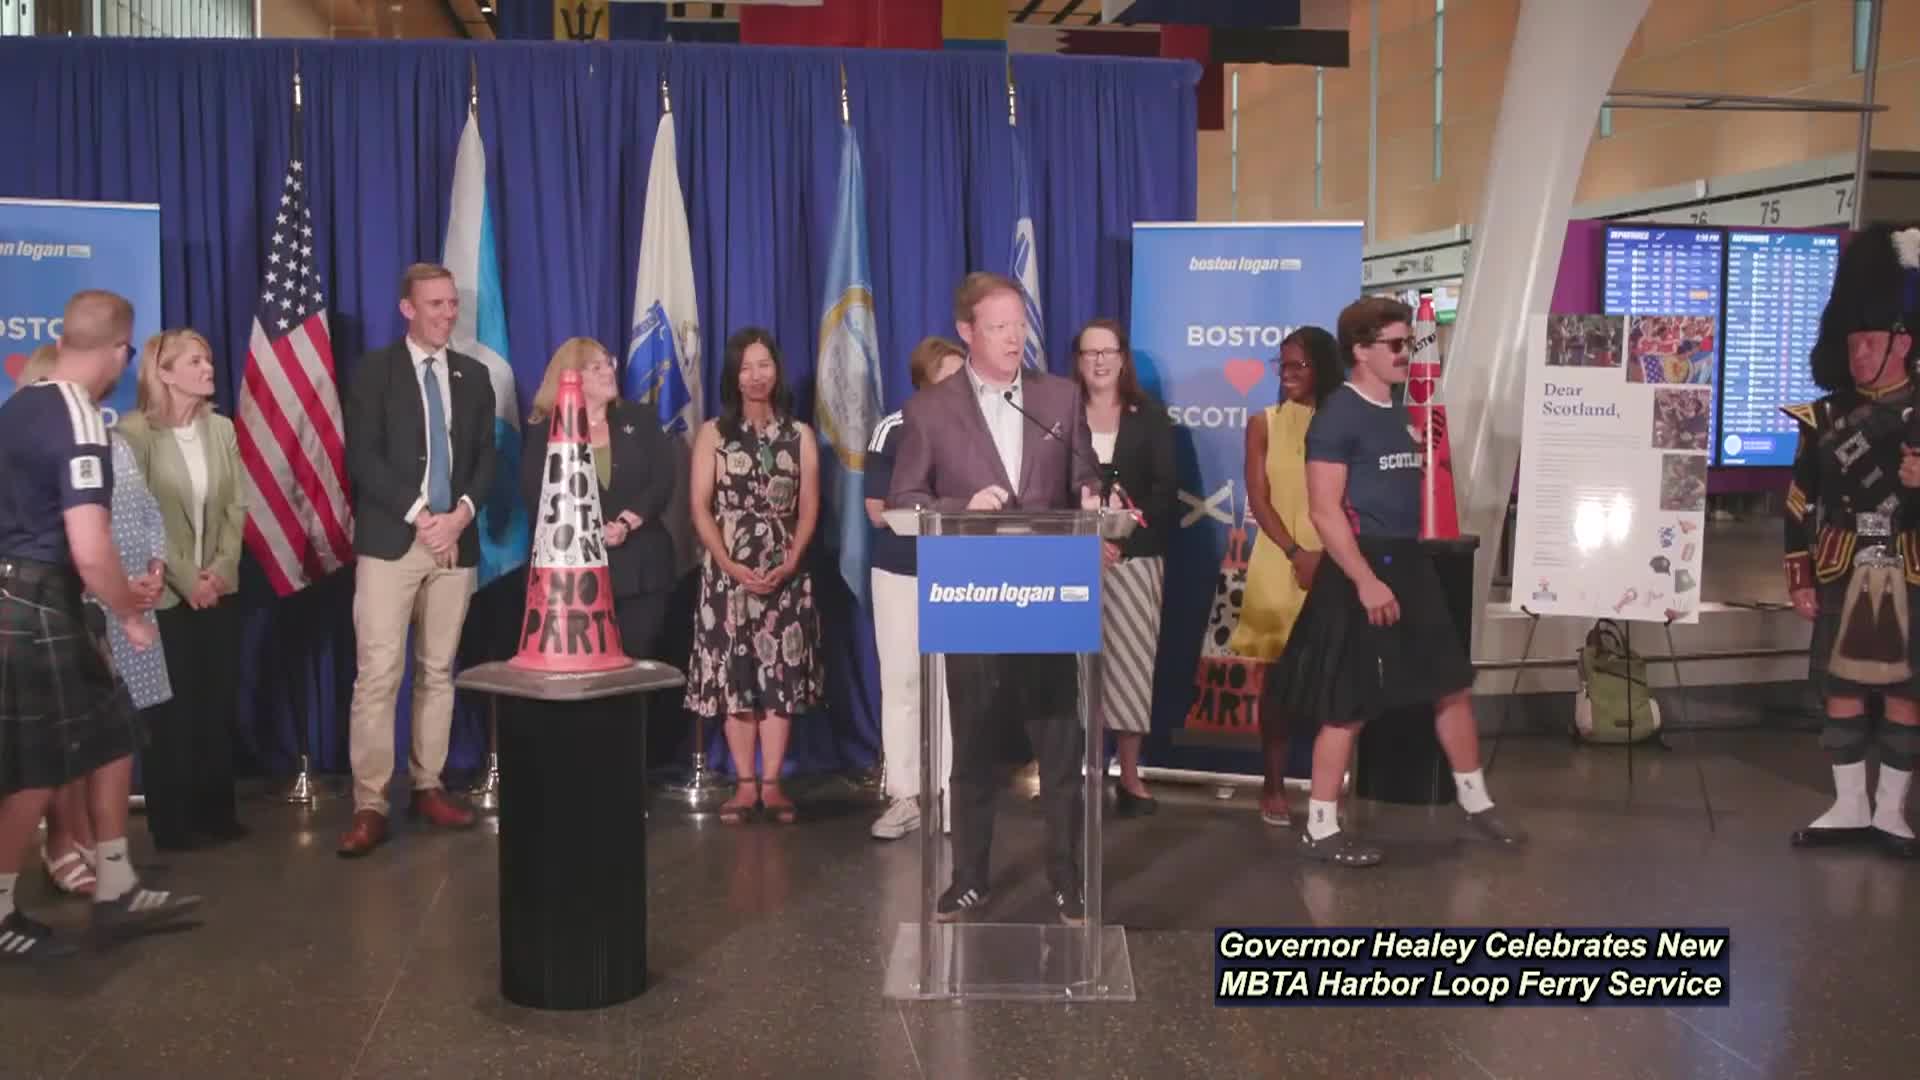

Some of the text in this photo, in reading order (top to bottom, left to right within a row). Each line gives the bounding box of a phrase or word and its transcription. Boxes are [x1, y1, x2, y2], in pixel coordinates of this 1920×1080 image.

[1760, 200, 1781, 225] 75
[17, 240, 65, 261] logan
[1189, 256, 1237, 271] boston
[1239, 257, 1278, 275] logan
[1543, 383, 1583, 397] Dear
[552, 405, 590, 439] NO
[1542, 401, 1621, 420] Scotland,
[550, 571, 599, 606] NO
[929, 582, 998, 602] boston
[999, 582, 1056, 608] logan
[1194, 689, 1257, 727] ART
